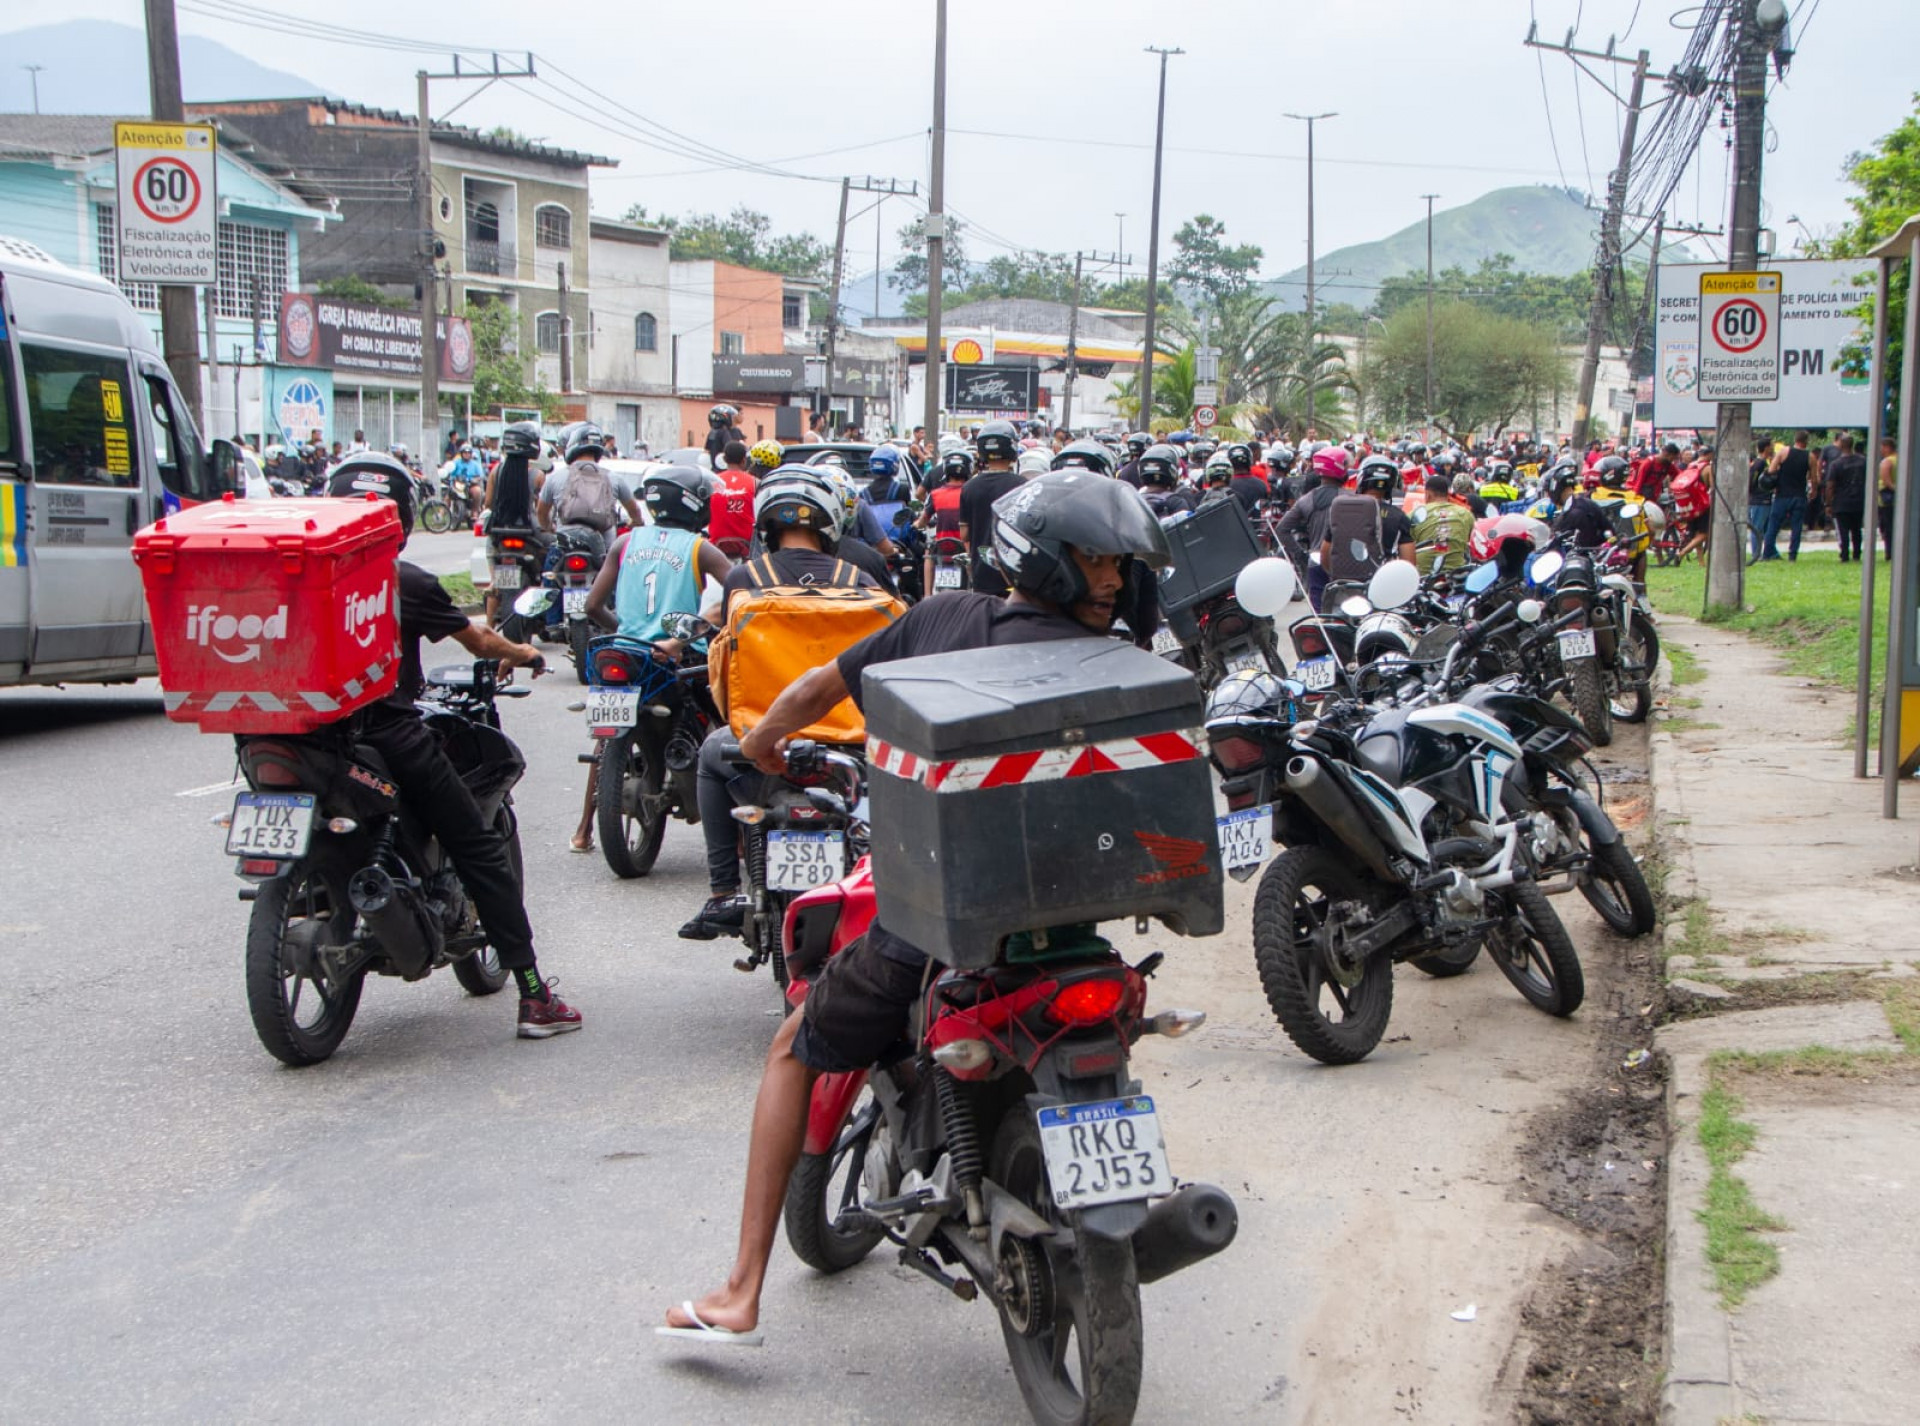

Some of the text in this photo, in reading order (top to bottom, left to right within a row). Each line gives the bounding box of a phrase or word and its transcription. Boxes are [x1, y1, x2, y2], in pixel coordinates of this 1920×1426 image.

[121, 131, 183, 147] Atenção
[148, 167, 187, 202] 60
[125, 228, 211, 245] Fiscalização
[123, 245, 214, 260] Eletrônica de
[130, 263, 208, 276] Velocidade
[1705, 279, 1755, 291] Atenção
[1660, 297, 1699, 308] SECRET
[1781, 294, 1795, 304] DE
[1798, 291, 1838, 304] POLÍCIA
[318, 304, 346, 330] IGREJA
[347, 307, 396, 333] EVANGÉLICA
[1673, 313, 1699, 323] COM
[1781, 310, 1831, 320] AMENTO
[1724, 307, 1756, 336] 60
[342, 334, 352, 350] EM
[354, 336, 374, 352] OBRA
[375, 338, 385, 354] DE
[1703, 357, 1774, 370] Fiscalização
[1783, 350, 1824, 376] PM
[1701, 371, 1776, 382] Eletrônica de
[1707, 385, 1771, 395] Velocidade
[1200, 410, 1213, 421] 60
[643, 570, 657, 617] 1
[345, 580, 388, 636] ifood
[187, 605, 288, 646] ifood
[254, 806, 295, 827] TUX
[238, 827, 298, 849] 1E33
[1222, 819, 1257, 844] RKT
[785, 843, 826, 863] SSA
[1075, 1107, 1118, 1122] BRASIL
[1069, 1118, 1138, 1158] RKQ
[1065, 1151, 1156, 1195] 2J53
[1056, 1191, 1070, 1205] BR
